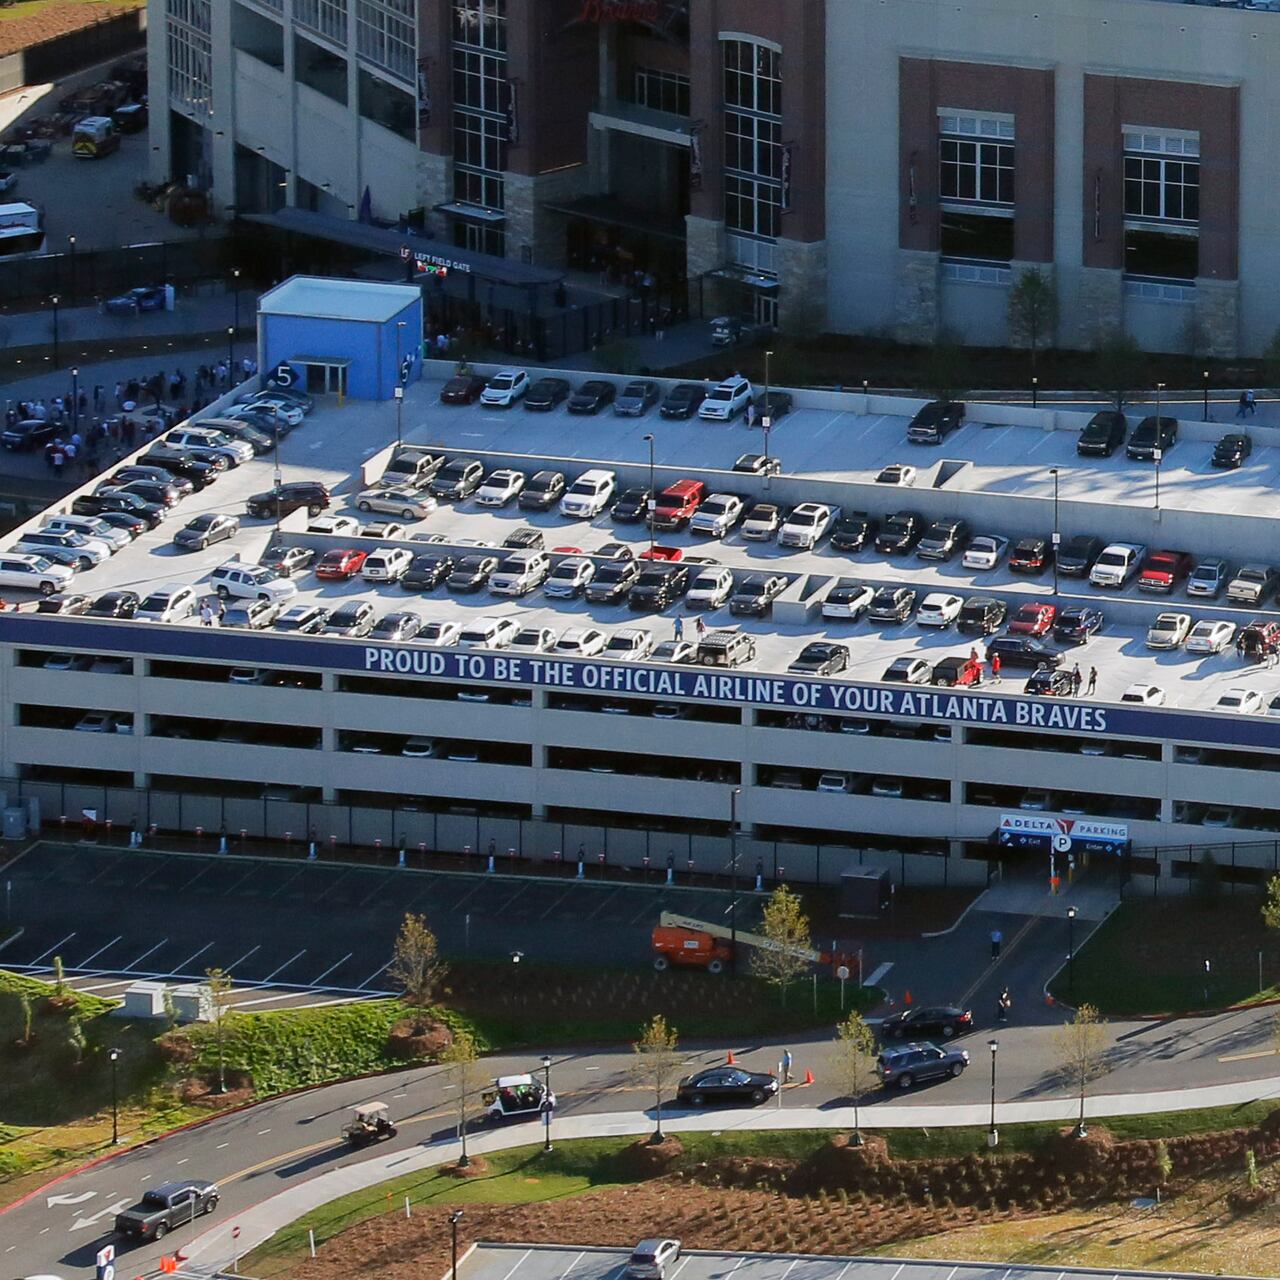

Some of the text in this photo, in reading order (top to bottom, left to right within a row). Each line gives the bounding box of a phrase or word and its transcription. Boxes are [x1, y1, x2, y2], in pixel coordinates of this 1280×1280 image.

[414, 252, 431, 261] LEFT
[432, 255, 452, 267] FIELD
[453, 261, 471, 273] GATE
[277, 366, 291, 386] 5
[365, 647, 1107, 731] PROUD TO BE THE OFFICIAL AIRLINE OF YOUR ATLANTA BRAVES
[1014, 819, 1126, 837] DELTA PARKING
[1059, 837, 1067, 848] P
